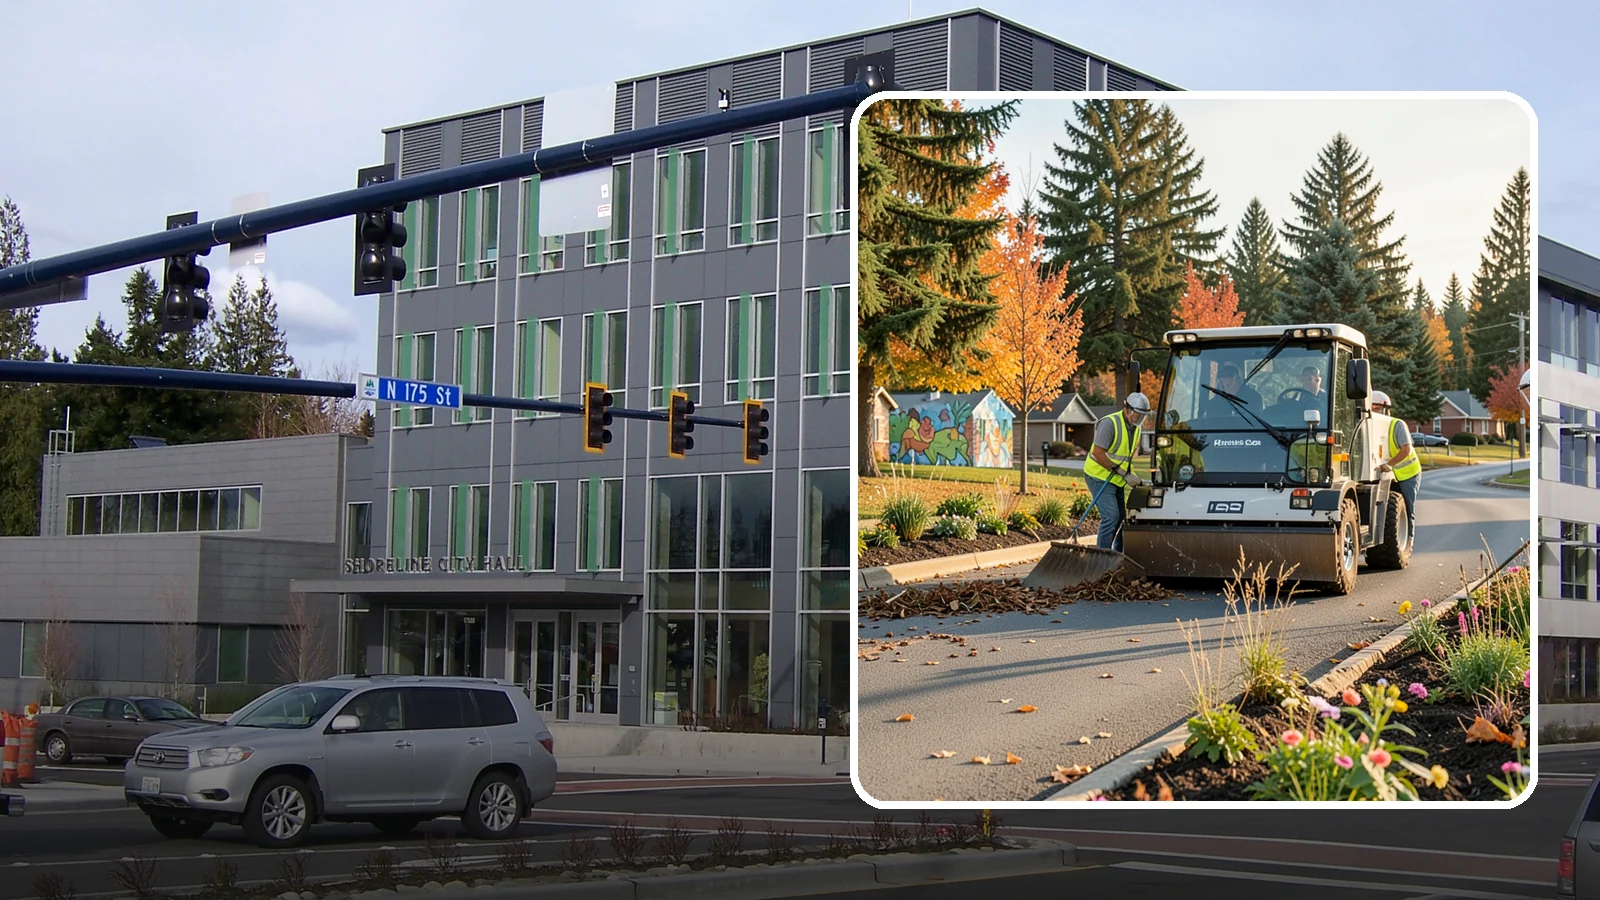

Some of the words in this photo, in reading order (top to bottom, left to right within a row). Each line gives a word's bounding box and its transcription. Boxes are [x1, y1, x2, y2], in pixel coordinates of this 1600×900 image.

[387, 380, 396, 400] N
[405, 382, 427, 403] 175
[436, 386, 451, 406] St
[344, 556, 432, 574] SHORELINE
[438, 556, 475, 572] CITY
[484, 555, 525, 571] HALL
